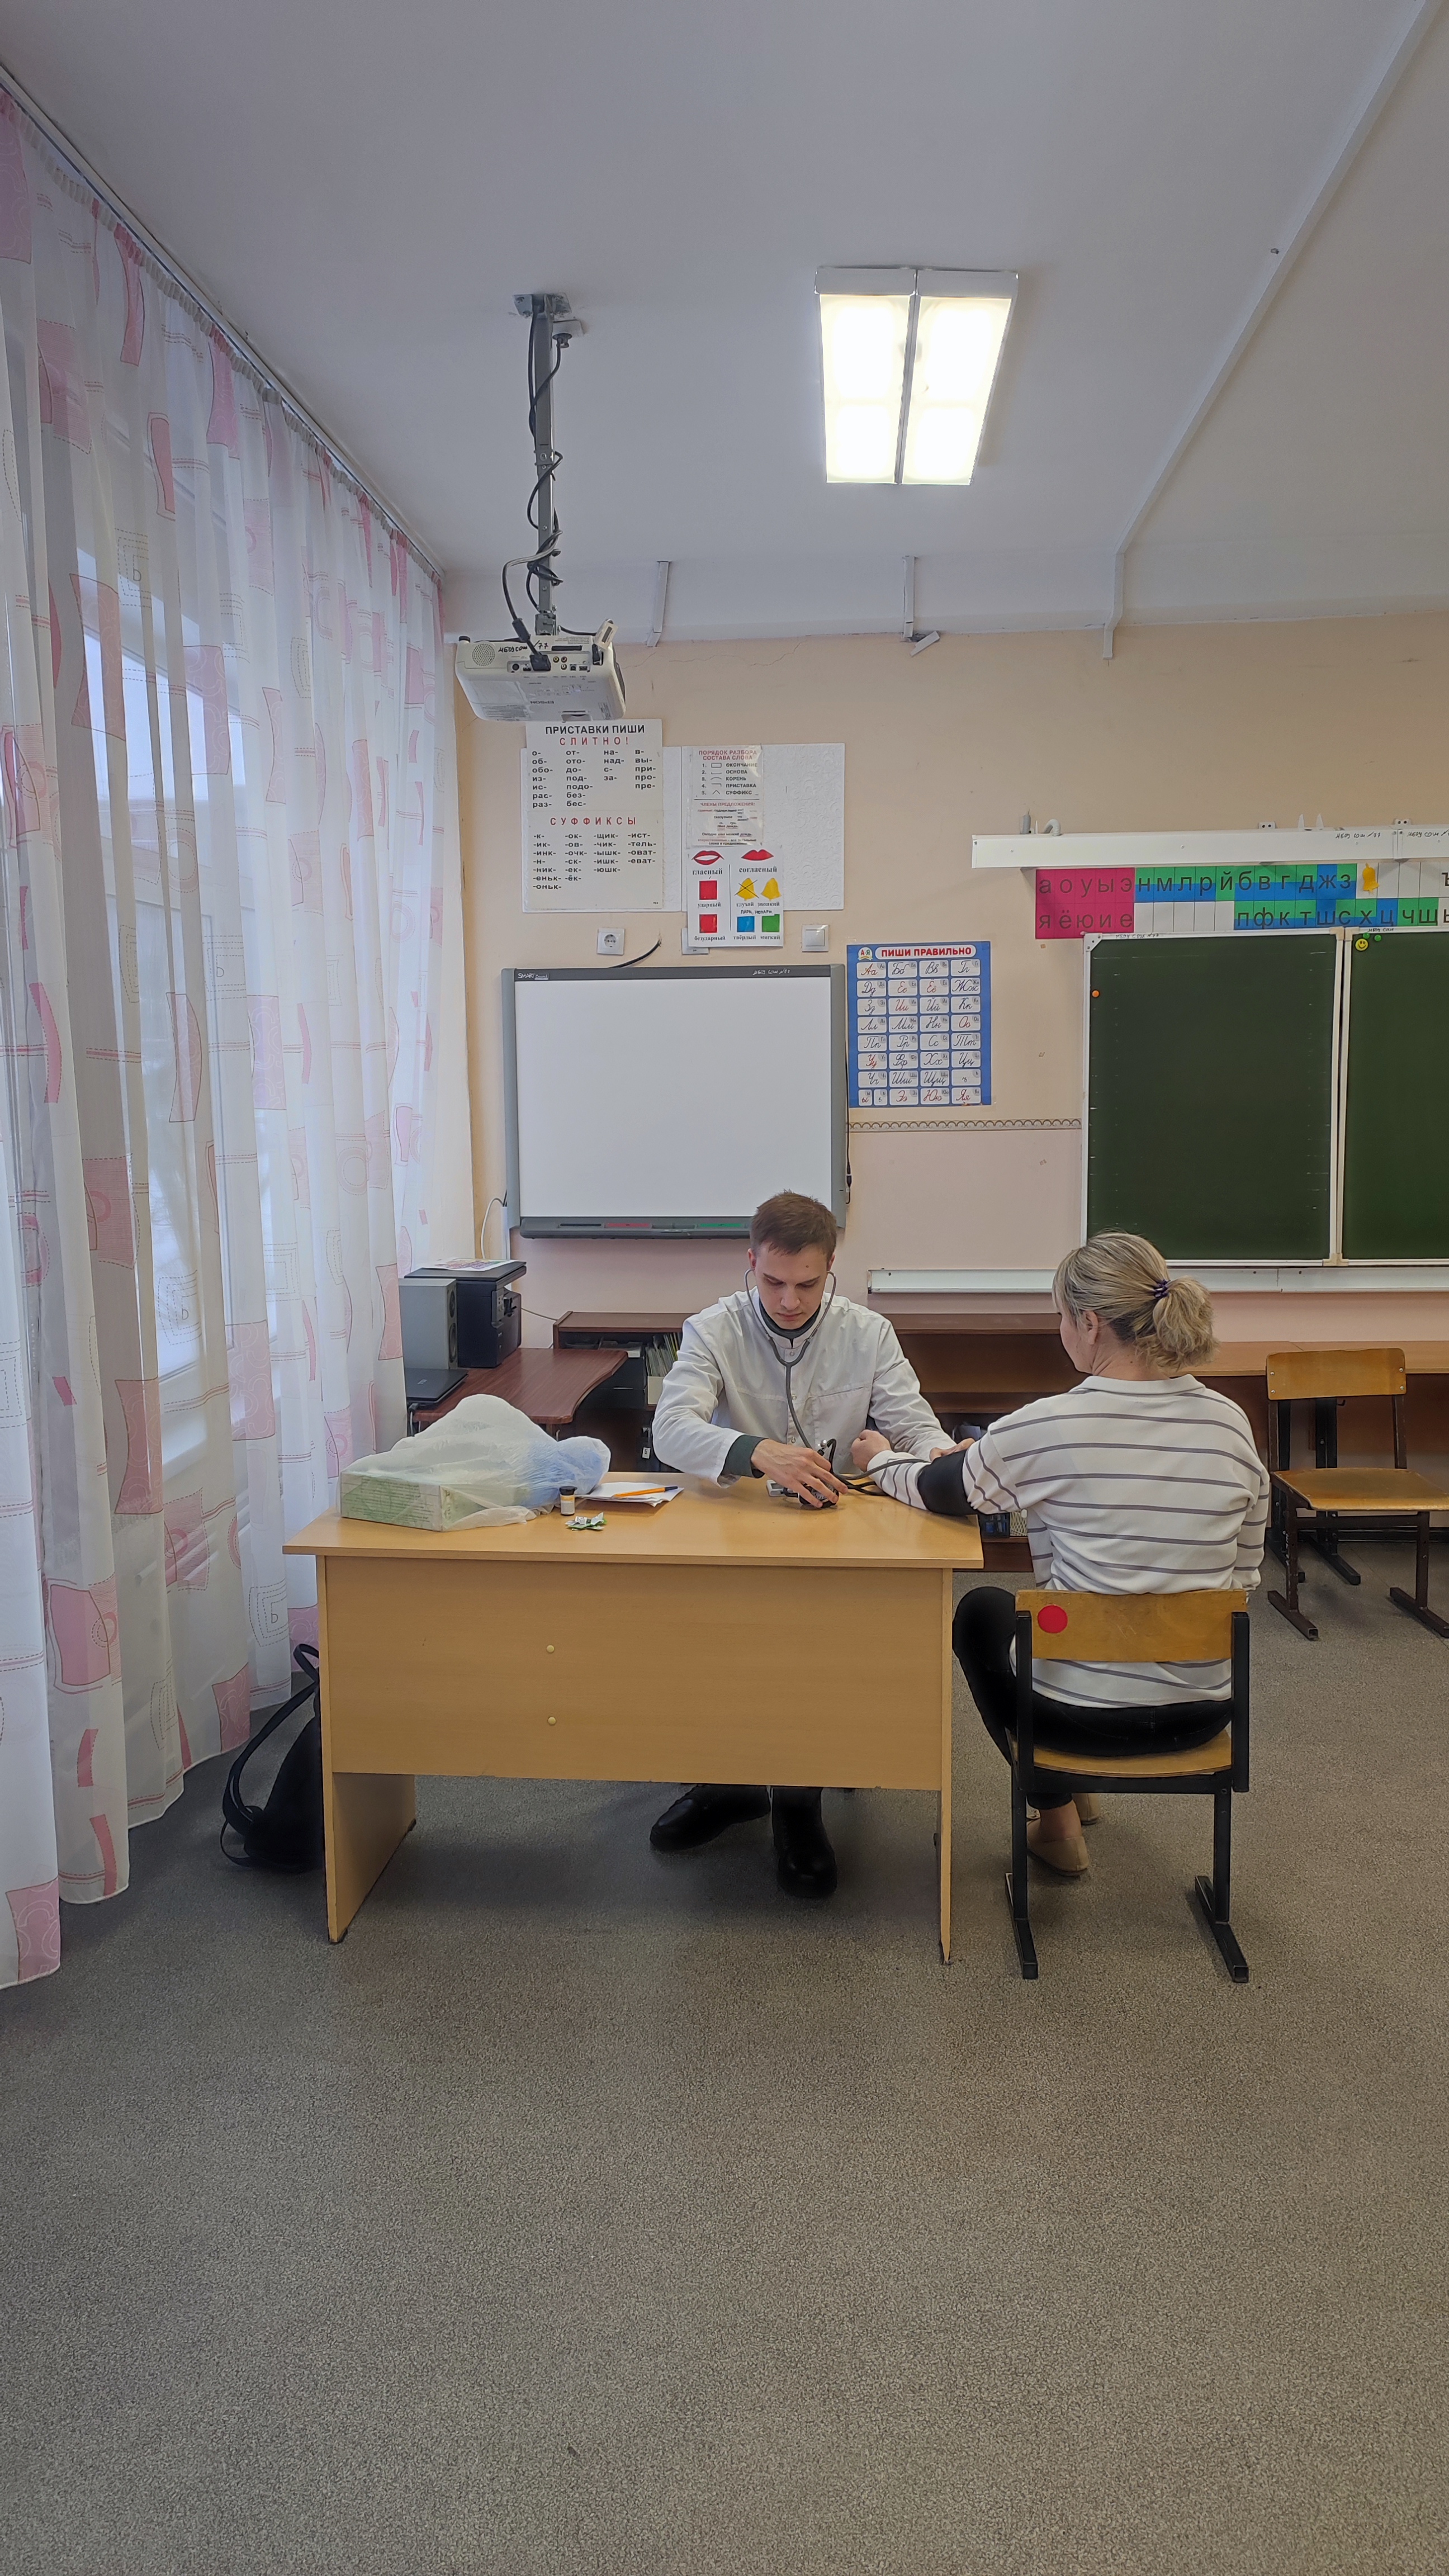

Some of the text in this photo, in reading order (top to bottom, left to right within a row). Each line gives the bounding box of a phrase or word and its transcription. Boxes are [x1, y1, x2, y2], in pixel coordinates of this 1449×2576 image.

[546, 724, 645, 735] ПРИСТАВКИ ПИШИ
[560, 736, 628, 746] СЛИТНО!
[551, 817, 636, 826] СУФФИКСЫ
[914, 947, 971, 956] ПРАВИЛЬНО
